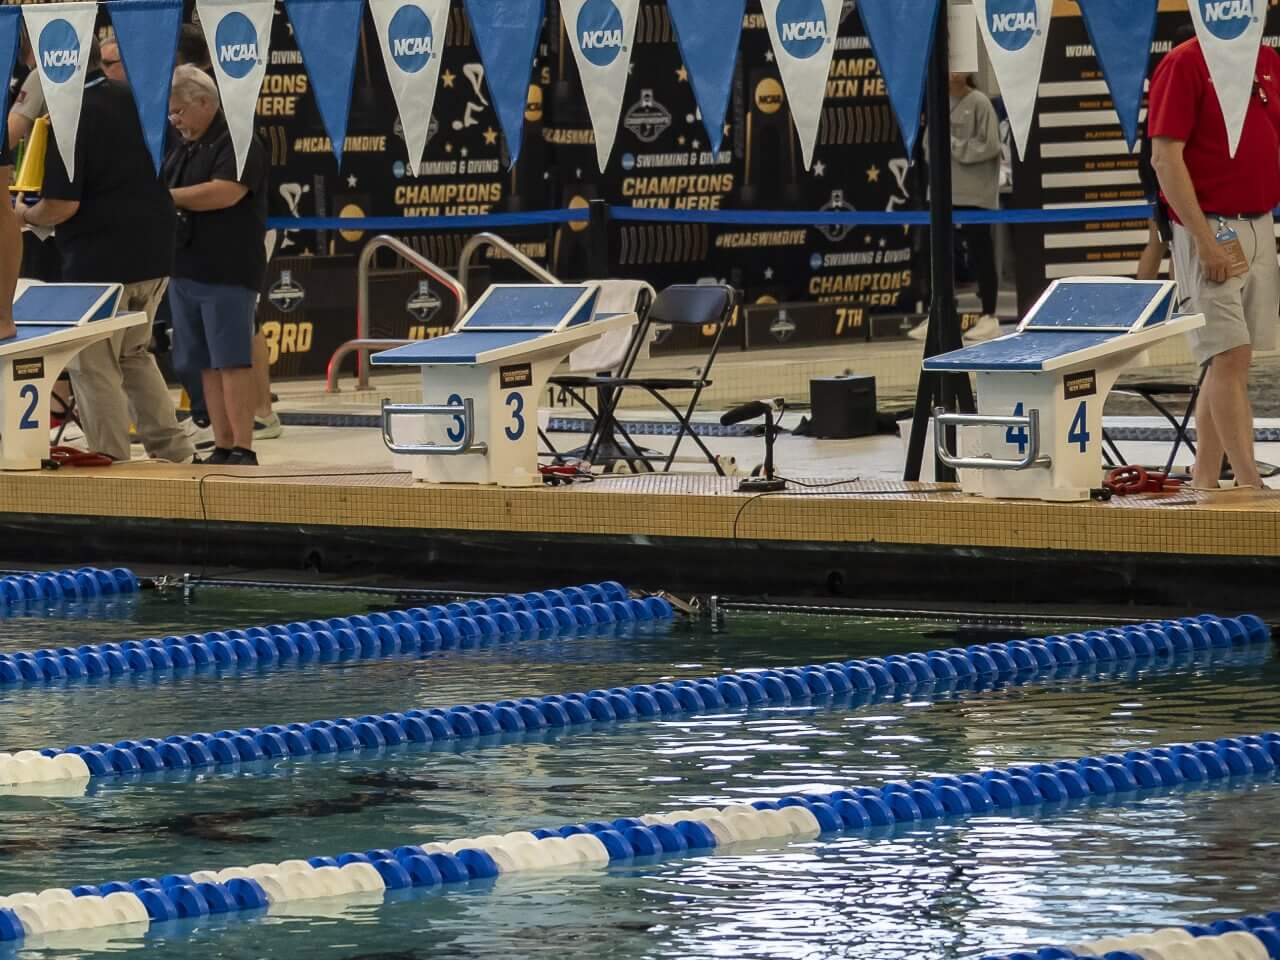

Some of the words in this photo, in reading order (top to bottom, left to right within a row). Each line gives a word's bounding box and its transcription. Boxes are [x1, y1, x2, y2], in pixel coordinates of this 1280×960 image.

[1205, 0, 1254, 23] NCAA
[782, 20, 827, 41] NCAA
[991, 12, 1038, 33] NCAA
[394, 36, 433, 57] NCAA
[581, 29, 623, 49] NCAA
[43, 50, 81, 67] NCAA
[220, 43, 259, 62] NCAA
[271, 50, 303, 64] DIVING
[863, 78, 887, 96] HE
[294, 136, 387, 153] #NCAAIMDIVE
[405, 161, 456, 175] SIMMING
[468, 159, 499, 173] DIVING
[636, 153, 689, 169] SWIMMING
[699, 150, 732, 166] DING
[394, 183, 502, 205] CHAMPIONS
[622, 173, 734, 196] CHAMPIONS
[675, 195, 721, 211] HERE
[715, 229, 807, 248] #NCAASWIMDIVE
[823, 251, 873, 267] SWIMMING
[809, 269, 912, 294] CHAMPIONS
[835, 307, 863, 335] 7TH
[262, 320, 314, 365] 3RD
[19, 383, 40, 430] 2
[504, 391, 525, 441] 3
[446, 393, 465, 443] 3
[1005, 401, 1029, 455] 4
[1067, 400, 1090, 454] 4
